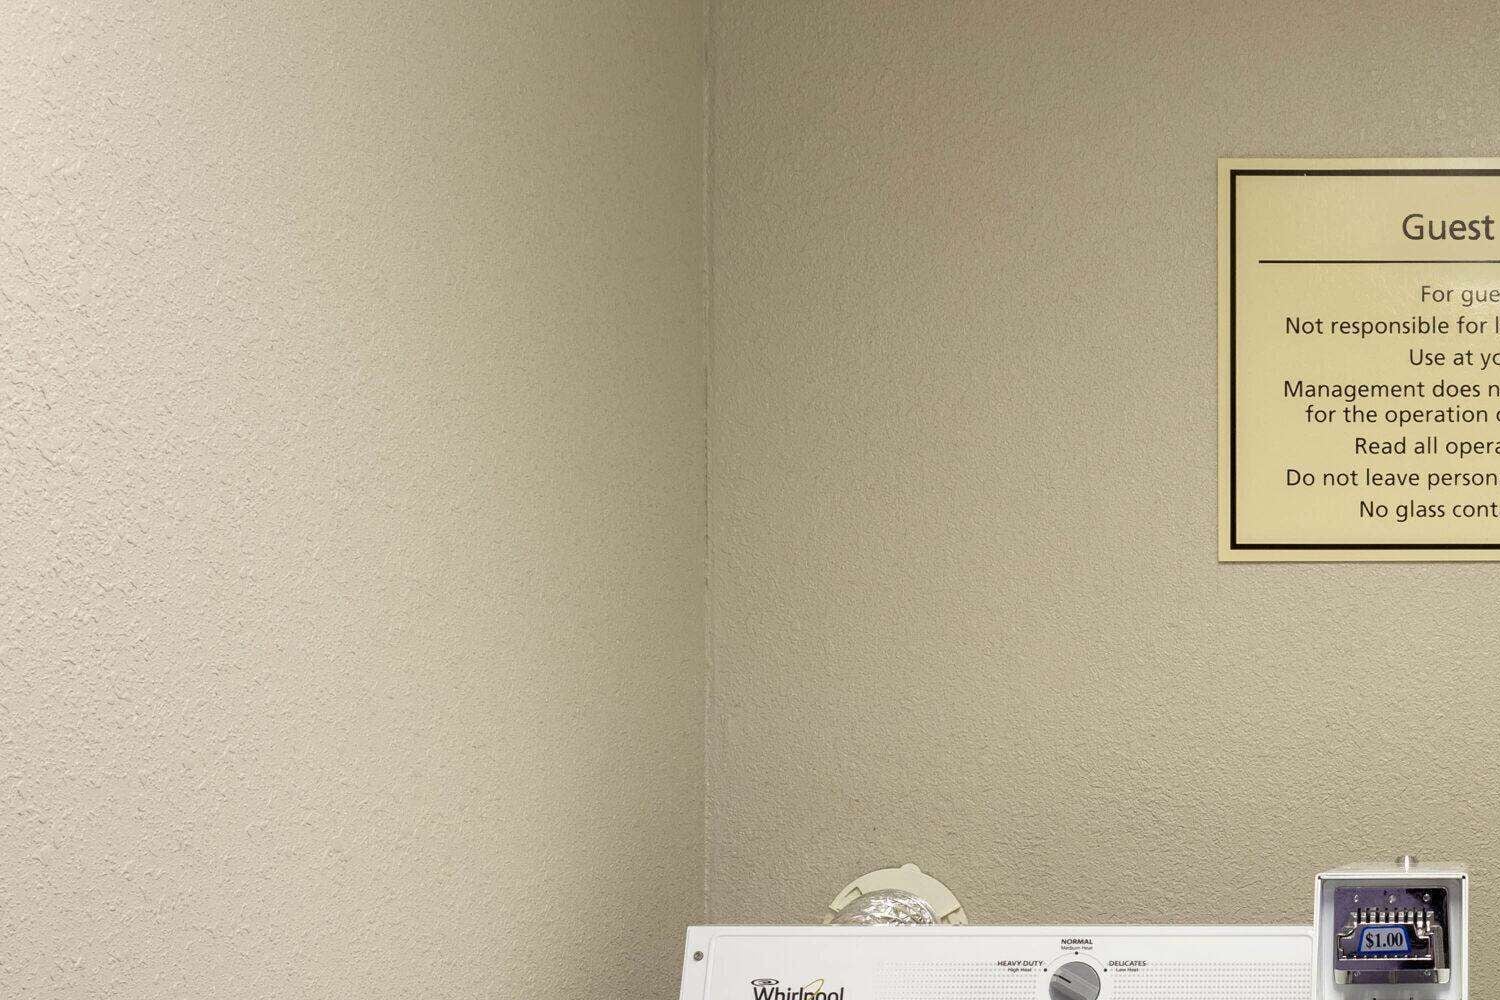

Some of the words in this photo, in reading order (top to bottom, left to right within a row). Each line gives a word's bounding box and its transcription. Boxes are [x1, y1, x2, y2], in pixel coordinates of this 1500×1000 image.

[1400, 213, 1496, 241] Guest
[1421, 285, 1455, 305] For
[1285, 316, 1324, 337] Not
[1327, 315, 1450, 339] responsible
[1455, 314, 1489, 337] for
[1409, 348, 1448, 369] Use
[1452, 349, 1476, 369] at
[1283, 379, 1426, 402] Management
[1431, 378, 1481, 401] does
[1303, 402, 1337, 424] for
[1342, 403, 1378, 424] the
[1383, 404, 1489, 428] operation
[1354, 435, 1408, 457] Read
[1413, 435, 1439, 456] all
[1284, 468, 1316, 489] Do
[1321, 469, 1360, 488] not
[1366, 467, 1423, 489] leave
[1358, 500, 1389, 519] No
[1395, 499, 1446, 523] glass
[1365, 932, 1404, 948] $1.00
